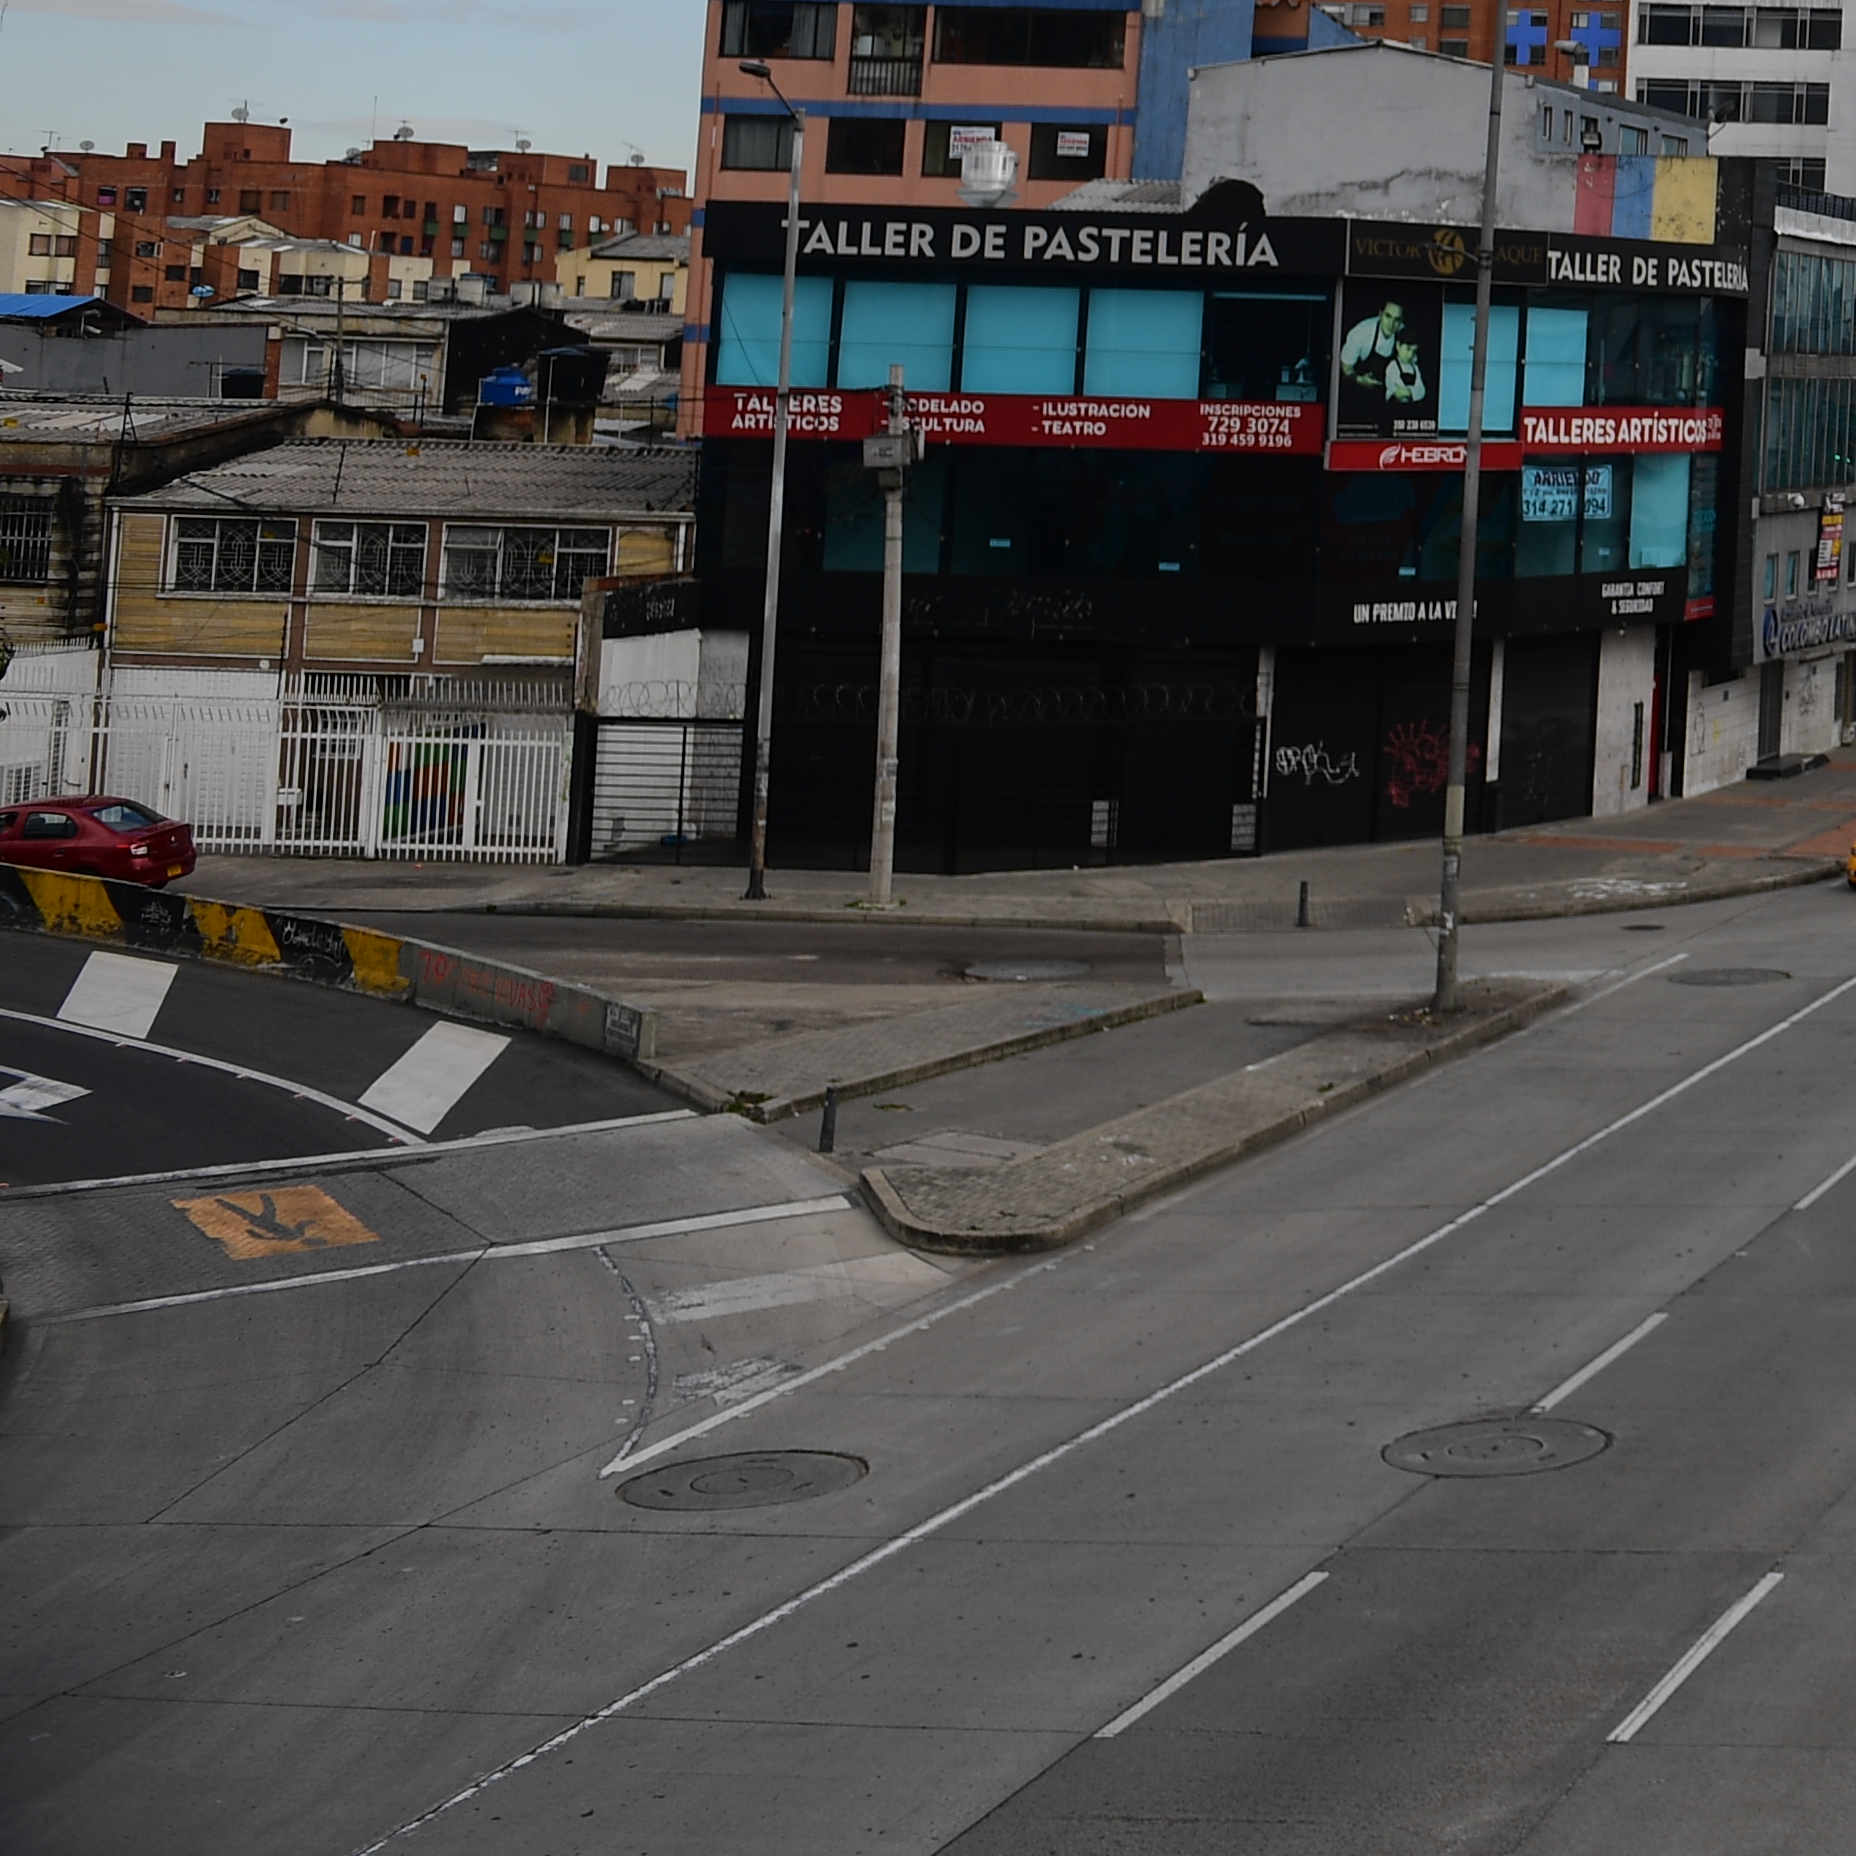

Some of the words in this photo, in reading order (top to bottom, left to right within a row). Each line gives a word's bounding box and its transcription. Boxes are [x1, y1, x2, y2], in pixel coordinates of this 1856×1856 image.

[782, 218, 935, 258] TALLER
[951, 223, 1006, 260] DE
[1023, 222, 1279, 268] PASTELERÍA
[1476, 243, 1543, 265] AQUE
[1547, 250, 1621, 283] TALLER
[1632, 256, 1658, 286] DE
[1667, 255, 1749, 292] PASTELERÍA
[733, 392, 843, 414] TALERES
[897, 398, 985, 415] ODELADO
[1042, 401, 1151, 419] ILUSTRACIÓN
[1199, 403, 1302, 418] INSCRIPCIONES
[897, 416, 986, 434] SCULTURA
[1042, 420, 1107, 436] TEATRO
[1207, 416, 1241, 434] 729
[1246, 417, 1291, 435] 3074
[1524, 416, 1616, 444] TALLERES
[1617, 410, 1707, 444] ARTÍSTICOS
[1202, 432, 1227, 447] 319
[1230, 432, 1257, 447] 459
[1258, 433, 1293, 448] 9196
[1534, 469, 1601, 487] ARRIEDO
[1523, 498, 1547, 515] 314
[1550, 498, 1573, 515] 271
[1353, 603, 1370, 624] UN
[1372, 601, 1416, 624] PREMIO
[1417, 602, 1428, 621] A
[1429, 601, 1443, 621] LA
[1444, 599, 1478, 621] VI!
